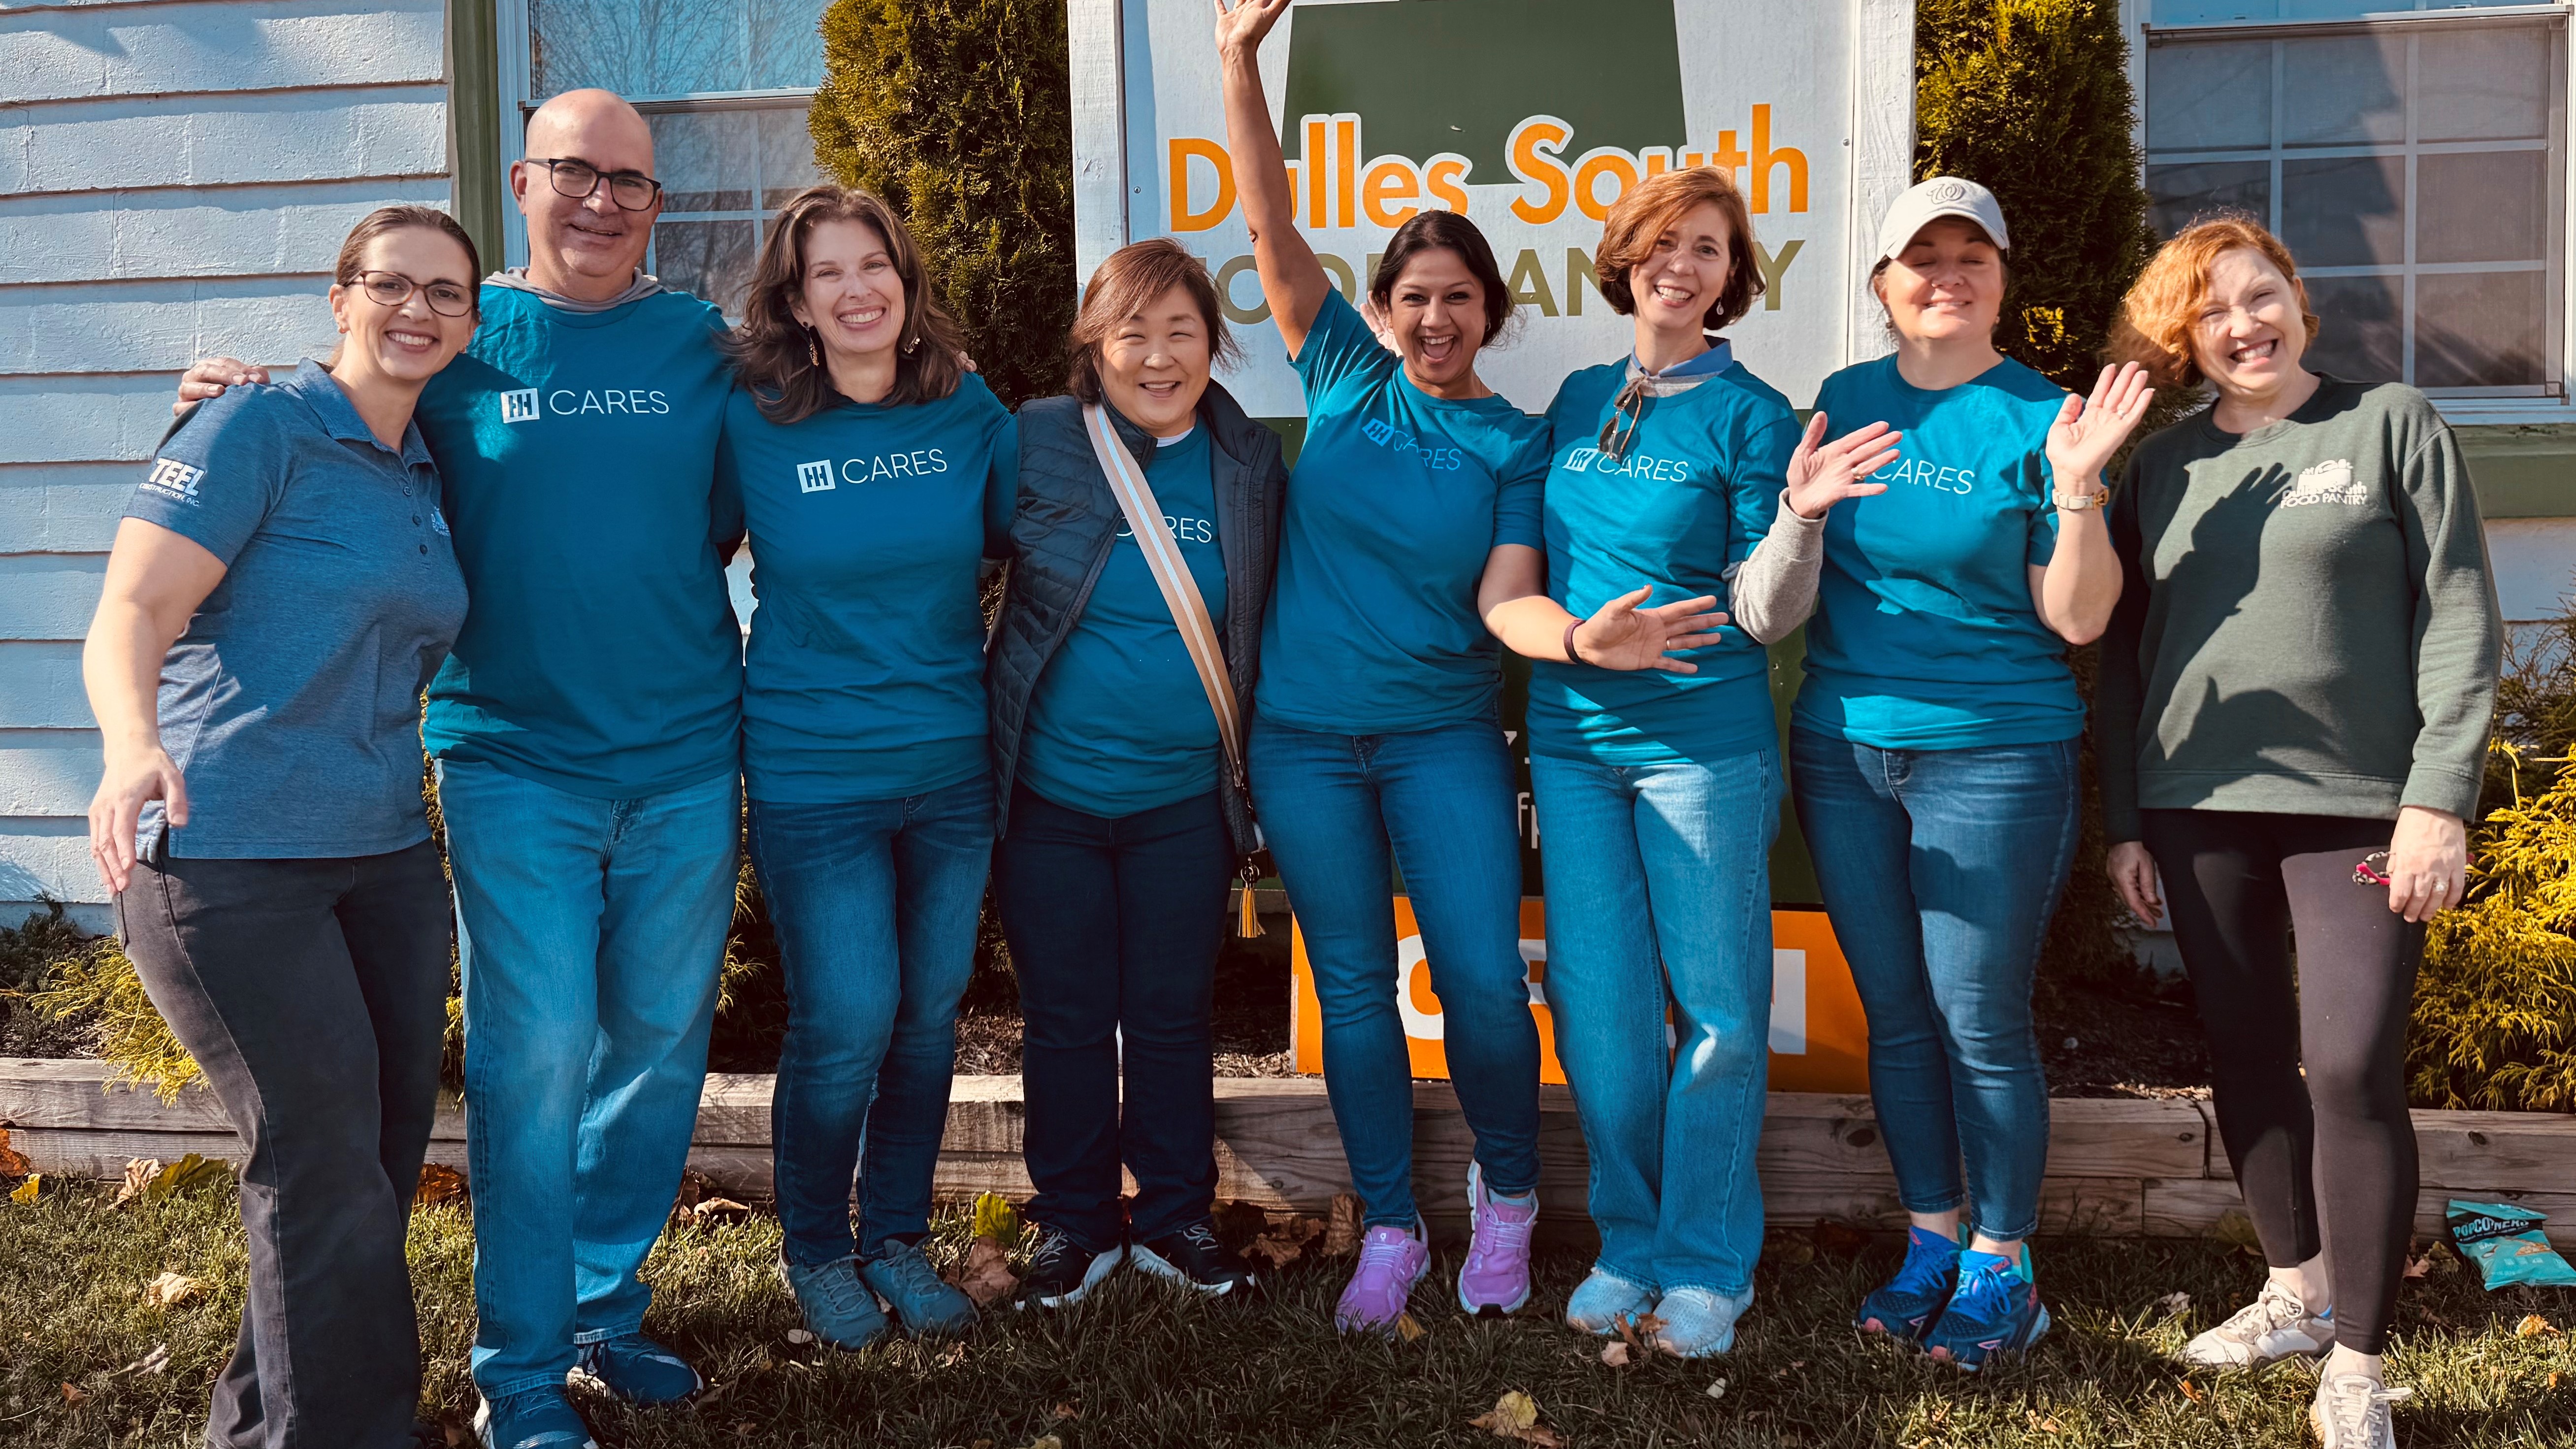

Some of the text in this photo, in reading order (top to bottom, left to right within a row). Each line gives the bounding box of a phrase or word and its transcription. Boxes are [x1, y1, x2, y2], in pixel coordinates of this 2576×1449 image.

[1169, 103, 1808, 232] Dlles Soth
[549, 389, 669, 415] CARES
[842, 448, 947, 484] CARES
[1394, 430, 1462, 470] CARES
[149, 458, 205, 497] TEEL
[1597, 453, 1689, 482] CARES
[2280, 493, 2368, 509] FOOD PANTRY
[1116, 516, 1212, 543] RES
